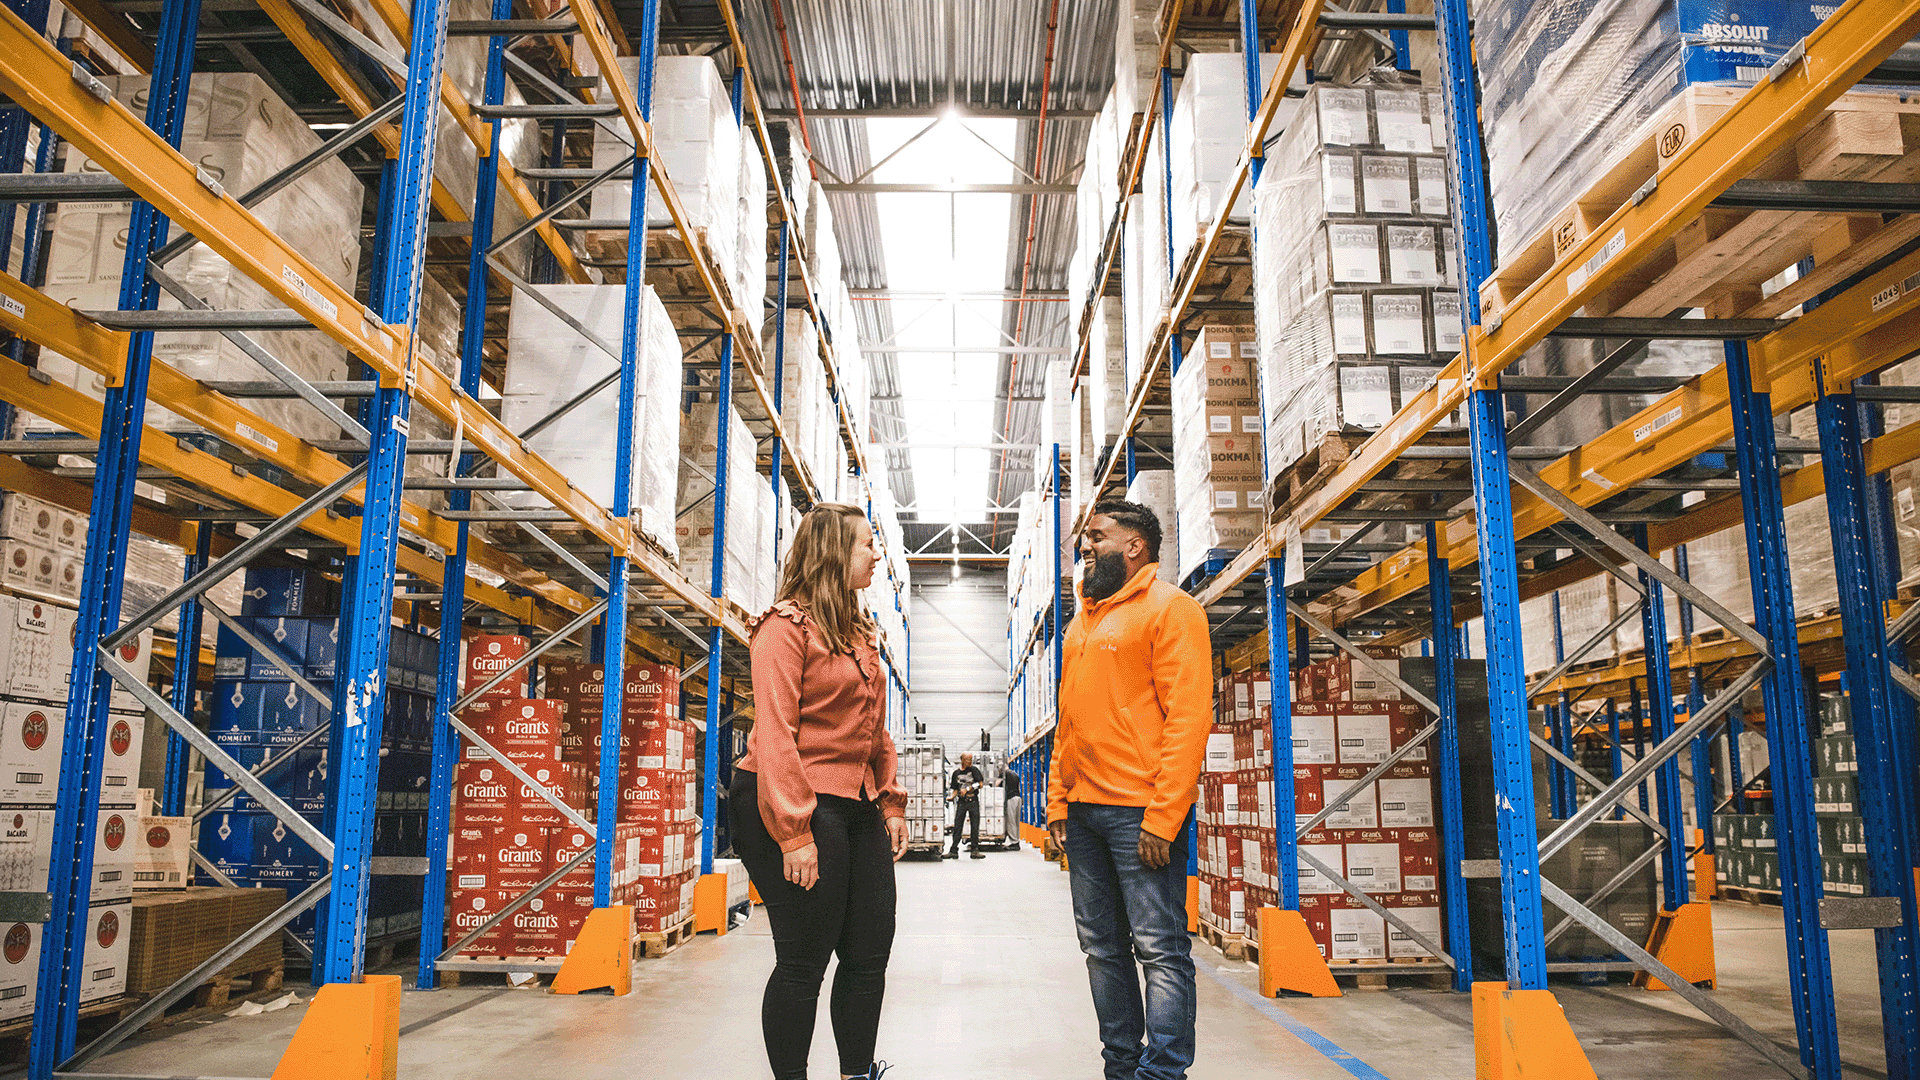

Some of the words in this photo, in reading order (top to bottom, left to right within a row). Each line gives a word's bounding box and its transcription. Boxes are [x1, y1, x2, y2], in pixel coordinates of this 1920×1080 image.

[1702, 23, 1768, 40] ABSOLUT
[1208, 378, 1248, 387] BOKMA
[1211, 454, 1250, 462] BOKMA
[292, 578, 301, 611] POMMERY
[626, 682, 662, 694] Grant's
[506, 720, 550, 734] Grant's
[464, 784, 508, 798] Grant's
[624, 788, 660, 800] Grant's
[498, 848, 543, 863] Grant's
[514, 914, 559, 928] Grant's
